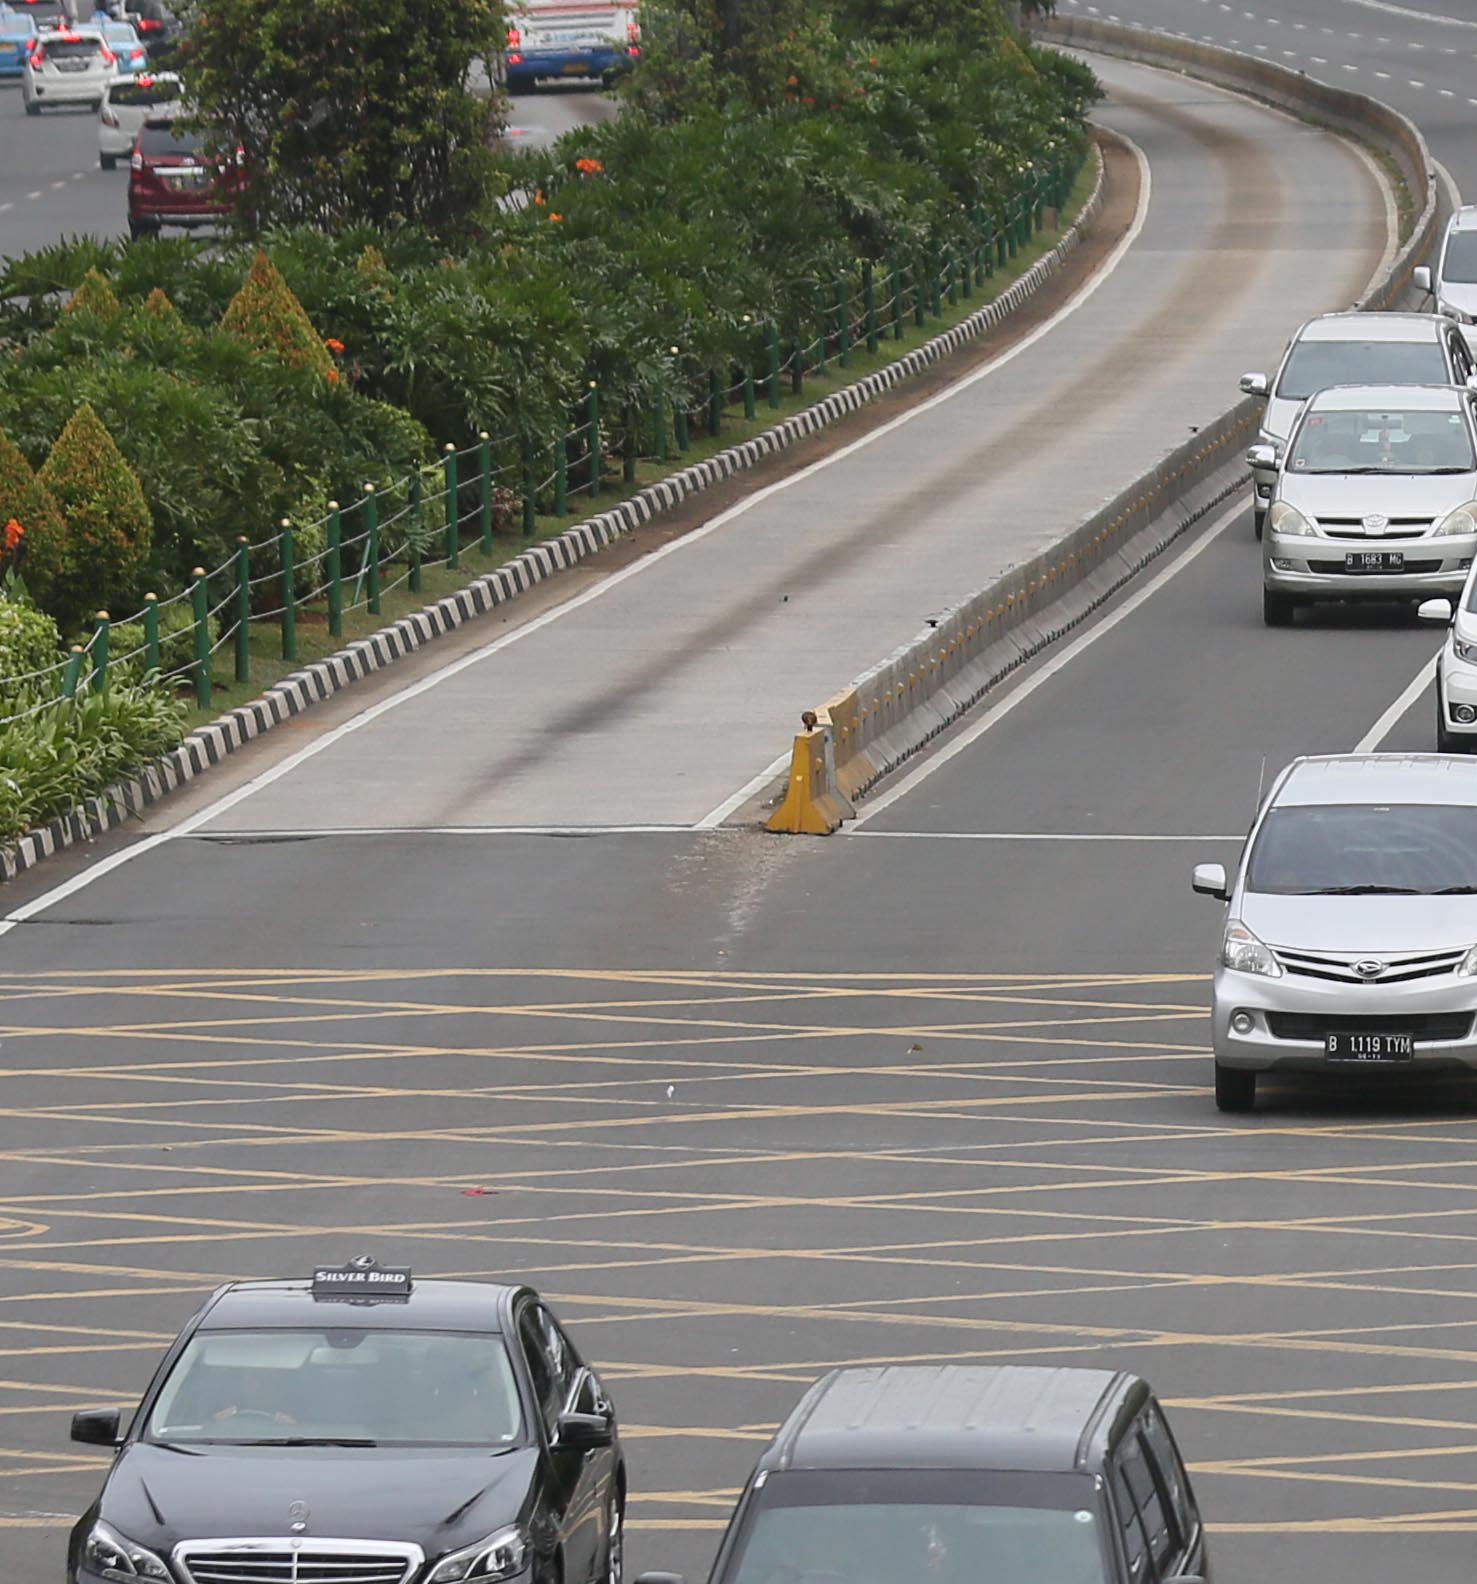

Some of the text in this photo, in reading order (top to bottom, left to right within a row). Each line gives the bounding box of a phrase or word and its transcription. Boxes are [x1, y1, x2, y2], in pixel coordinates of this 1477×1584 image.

[1347, 553, 1353, 565] B
[1361, 553, 1382, 565] 1683
[1329, 1036, 1410, 1053] B 1119 TYM
[315, 1271, 406, 1283] SILVER BIRD
